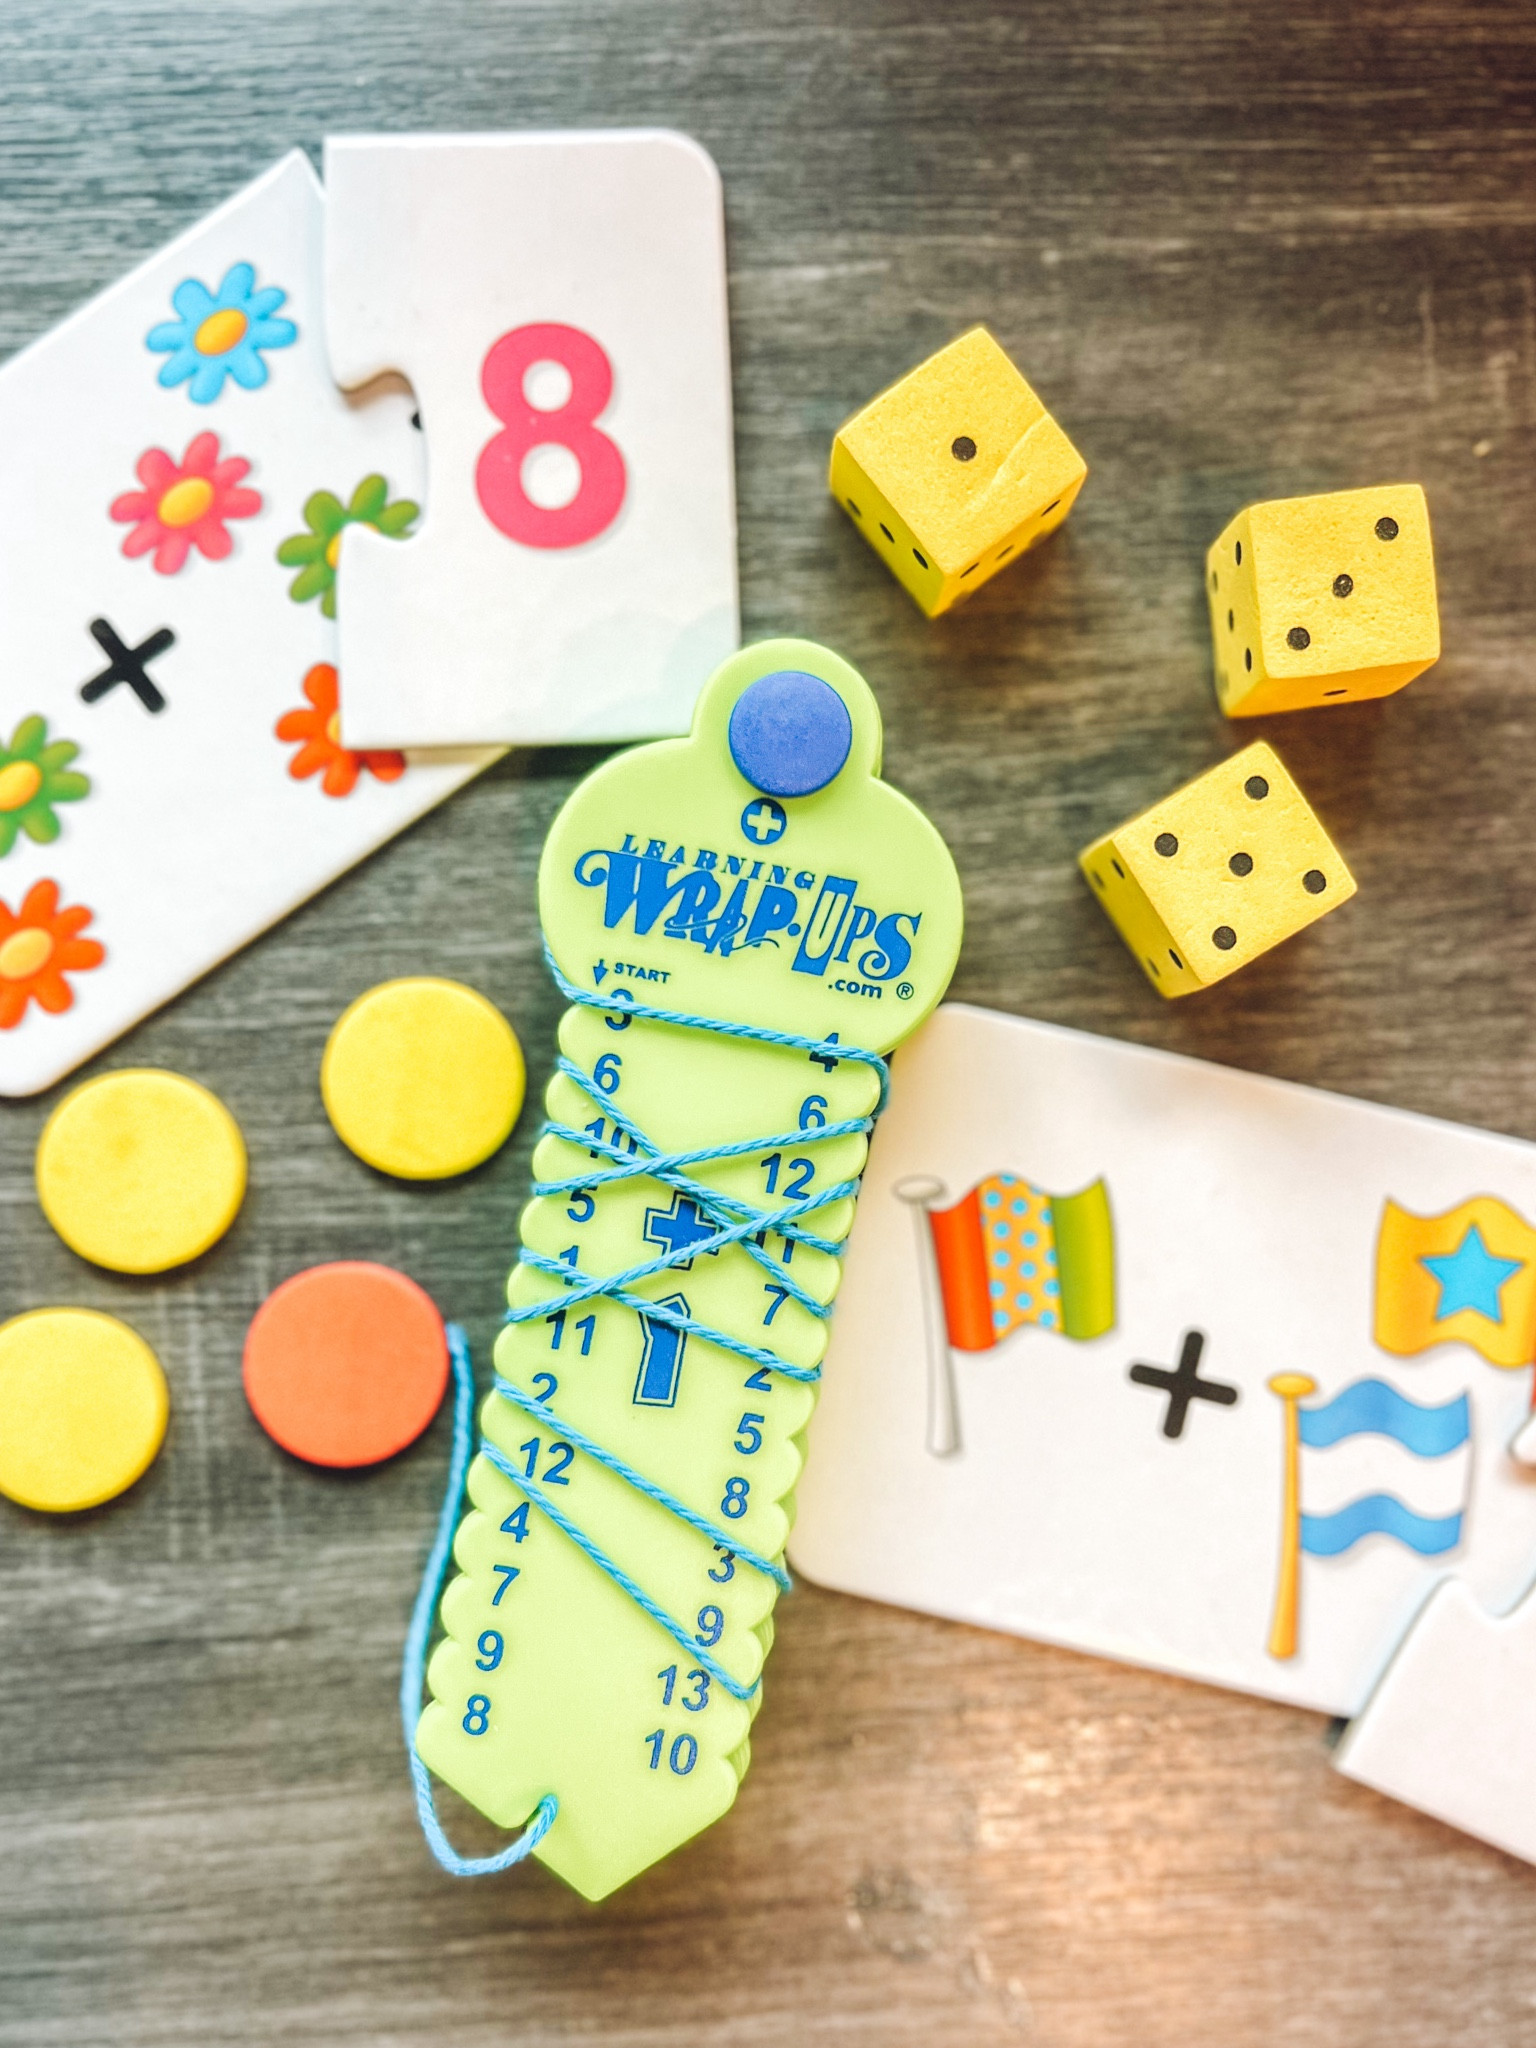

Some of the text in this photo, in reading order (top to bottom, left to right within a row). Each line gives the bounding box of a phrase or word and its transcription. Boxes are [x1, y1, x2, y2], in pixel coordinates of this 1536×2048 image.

[476, 322, 626, 549] 8
[620, 833, 817, 891] LEARNING
[614, 962, 671, 984] START
[827, 978, 883, 998] .com
[605, 988, 634, 1032] 3
[593, 1053, 622, 1095] 6
[809, 1032, 839, 1073] 4
[799, 1094, 828, 1131] 6
[584, 1116, 639, 1164] 10
[760, 1152, 815, 1200] 12
[566, 1184, 599, 1223] 5
[558, 1245, 580, 1286] 1
[763, 1284, 792, 1326] 7
[546, 1308, 597, 1356] 11
[744, 1348, 773, 1392] 2
[525, 1372, 558, 1412] 2
[734, 1413, 765, 1455] 5
[519, 1437, 575, 1486] 12
[720, 1476, 750, 1519] 8
[500, 1501, 530, 1543] 4
[491, 1564, 520, 1606] 7
[708, 1543, 736, 1584] 3
[695, 1604, 724, 1648] 9
[475, 1629, 504, 1672] 9
[657, 1664, 712, 1713] 13
[461, 1693, 492, 1736] 8
[644, 1728, 698, 1775] 10
